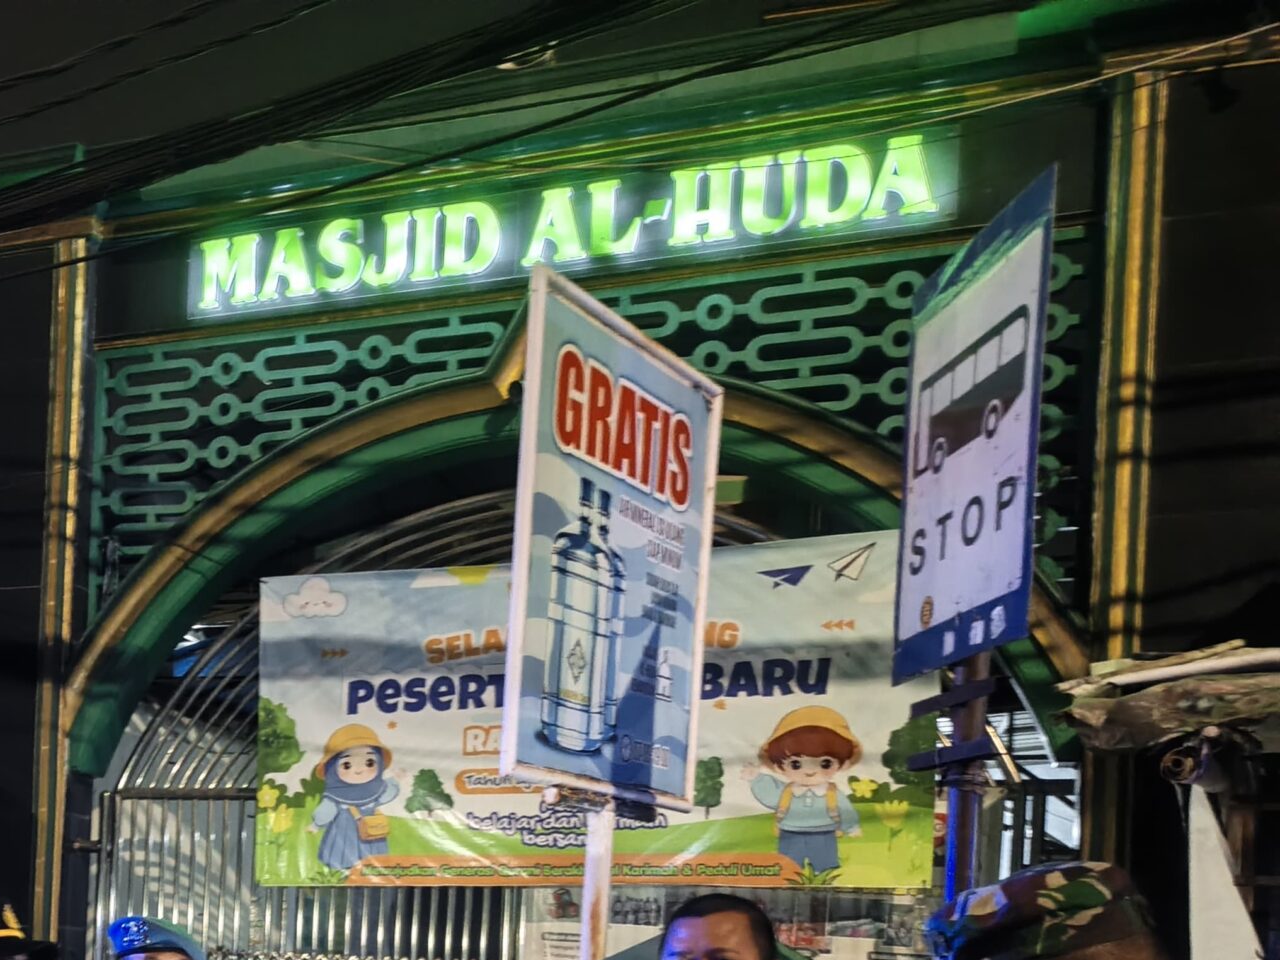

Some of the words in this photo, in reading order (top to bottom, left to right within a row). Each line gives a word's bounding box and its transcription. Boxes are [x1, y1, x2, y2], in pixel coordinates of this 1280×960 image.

[198, 200, 502, 310] MASJID
[521, 134, 940, 267] AL-HUDA
[555, 346, 692, 508] GRATIS
[909, 475, 1018, 576] STOP
[425, 629, 504, 664] SELA
[700, 658, 831, 700] BARU
[468, 812, 540, 836] belajar
[541, 811, 581, 830] dan
[523, 832, 587, 848] bersa
[623, 864, 677, 877] Karimah
[680, 864, 693, 877] &
[742, 863, 782, 877] Umat
